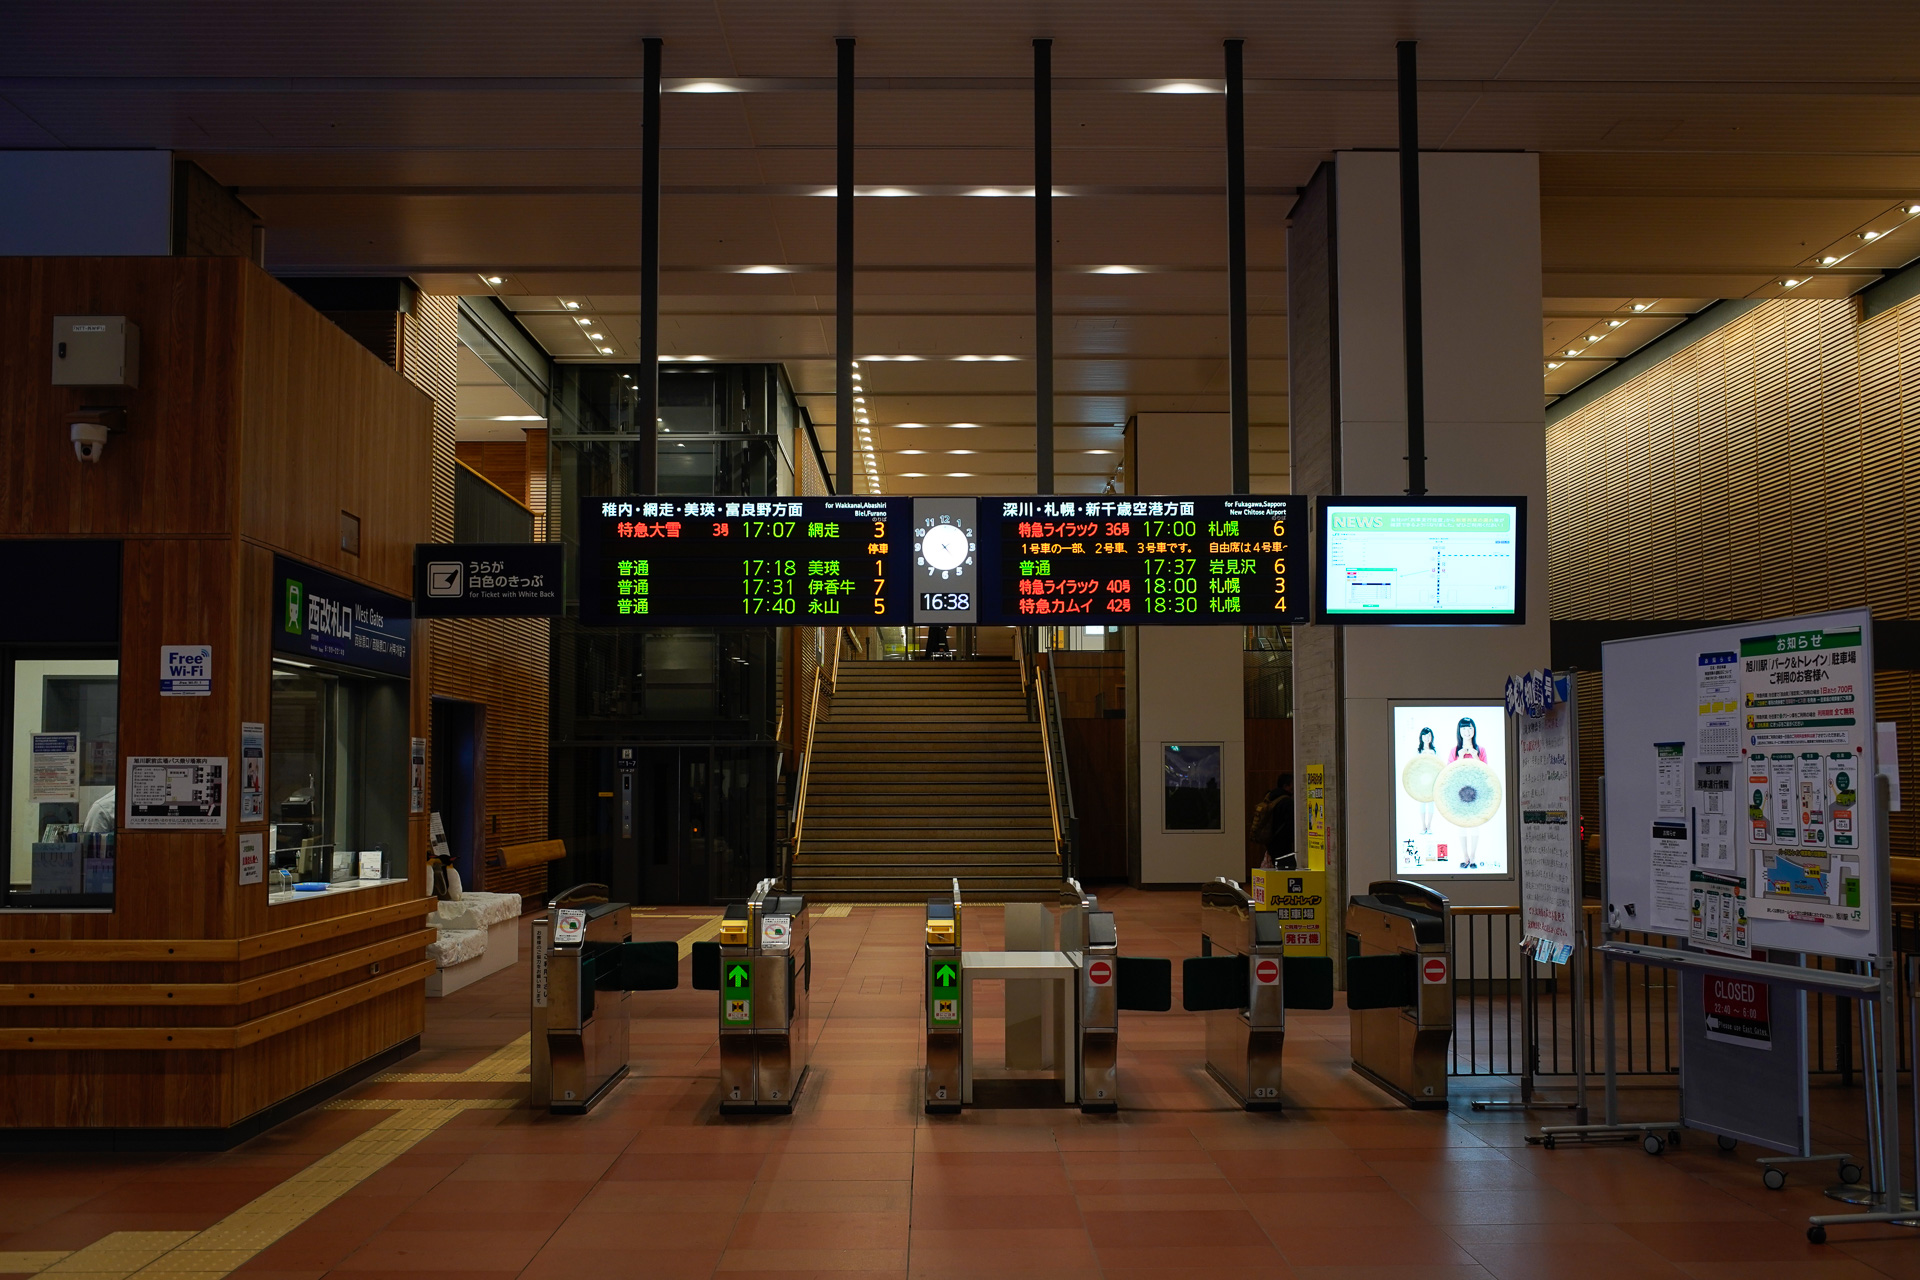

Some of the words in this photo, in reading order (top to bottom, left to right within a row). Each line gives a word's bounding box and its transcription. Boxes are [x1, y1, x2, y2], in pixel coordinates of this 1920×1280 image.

[602, 502, 802, 517] 稚内・網走・美瑛・富良野方面
[1003, 502, 1194, 517] 深川・札幌・新千歳空港方面
[925, 518, 934, 526] 11
[940, 515, 950, 524] 12
[956, 519, 961, 527] 1
[1333, 516, 1384, 528] NEWS
[618, 522, 681, 538] 特急大雪
[713, 523, 729, 536] 3号
[744, 522, 795, 537] 17:07
[808, 522, 839, 537] 網走
[874, 522, 884, 538] 3
[915, 528, 925, 537] 10
[966, 529, 972, 537] 2
[1019, 522, 1098, 538] 特急ライラック
[1106, 523, 1129, 536] 36号
[1144, 521, 1195, 536] 17:00
[1209, 521, 1239, 536] 札幌
[1274, 521, 1284, 536] 6
[868, 543, 888, 554] 停車
[914, 543, 921, 552] 9
[969, 543, 976, 551] 3
[918, 557, 924, 566] 8
[966, 557, 972, 565] 4
[470, 561, 503, 573] うらが
[618, 560, 648, 575] 普通
[743, 560, 796, 575] 17:18
[808, 560, 839, 576] 美瑛
[875, 560, 882, 576] 1
[928, 567, 935, 576] 7
[956, 567, 962, 576] 5
[1019, 560, 1050, 575] 普通
[1145, 559, 1196, 574] 17:37
[1210, 559, 1256, 574] 岩見沢
[1275, 559, 1285, 574] 6
[942, 571, 948, 579] 6
[470, 575, 543, 588] 白色のきっぷ
[618, 579, 648, 594] 普通
[743, 579, 792, 595] 17:31
[808, 579, 855, 595] 伊香牛
[874, 579, 885, 595] 7
[1019, 579, 1098, 595] 特急ライラック
[1106, 580, 1130, 593] 40号
[1145, 578, 1196, 594] 18:00
[1209, 578, 1240, 593] 札幌
[1275, 577, 1285, 593] 3
[618, 598, 648, 614] 普通
[743, 598, 795, 614] 17:40
[808, 598, 839, 614] 永山
[875, 598, 885, 614] 5
[924, 594, 969, 609] 16:38
[1019, 598, 1093, 614] 特急カムイ
[1107, 599, 1130, 612] 42号
[1145, 597, 1197, 613] 18:30
[1210, 597, 1240, 612] 札幌
[1275, 597, 1286, 612] 4
[309, 594, 352, 640] 西改札口
[355, 603, 368, 624] West
[370, 608, 384, 628] Gates
[1777, 634, 1822, 651] お知らせ
[170, 652, 203, 664] Free
[170, 666, 203, 676] Wi-Fi
[1770, 670, 1829, 684] ご利用のお客様へ
[1834, 708, 1854, 716] 全て無料
[1706, 766, 1721, 774] 旭川駅
[1271, 895, 1322, 905] パーク&トレイン
[1279, 909, 1314, 919] 駐車場
[1851, 911, 1861, 919] JR
[1286, 934, 1319, 944] 発行機
[1715, 980, 1755, 1003] CLOSED
[1714, 1003, 1730, 1015] 22:40
[1742, 1007, 1757, 1018] 6:00
[1742, 1025, 1752, 1034] East
